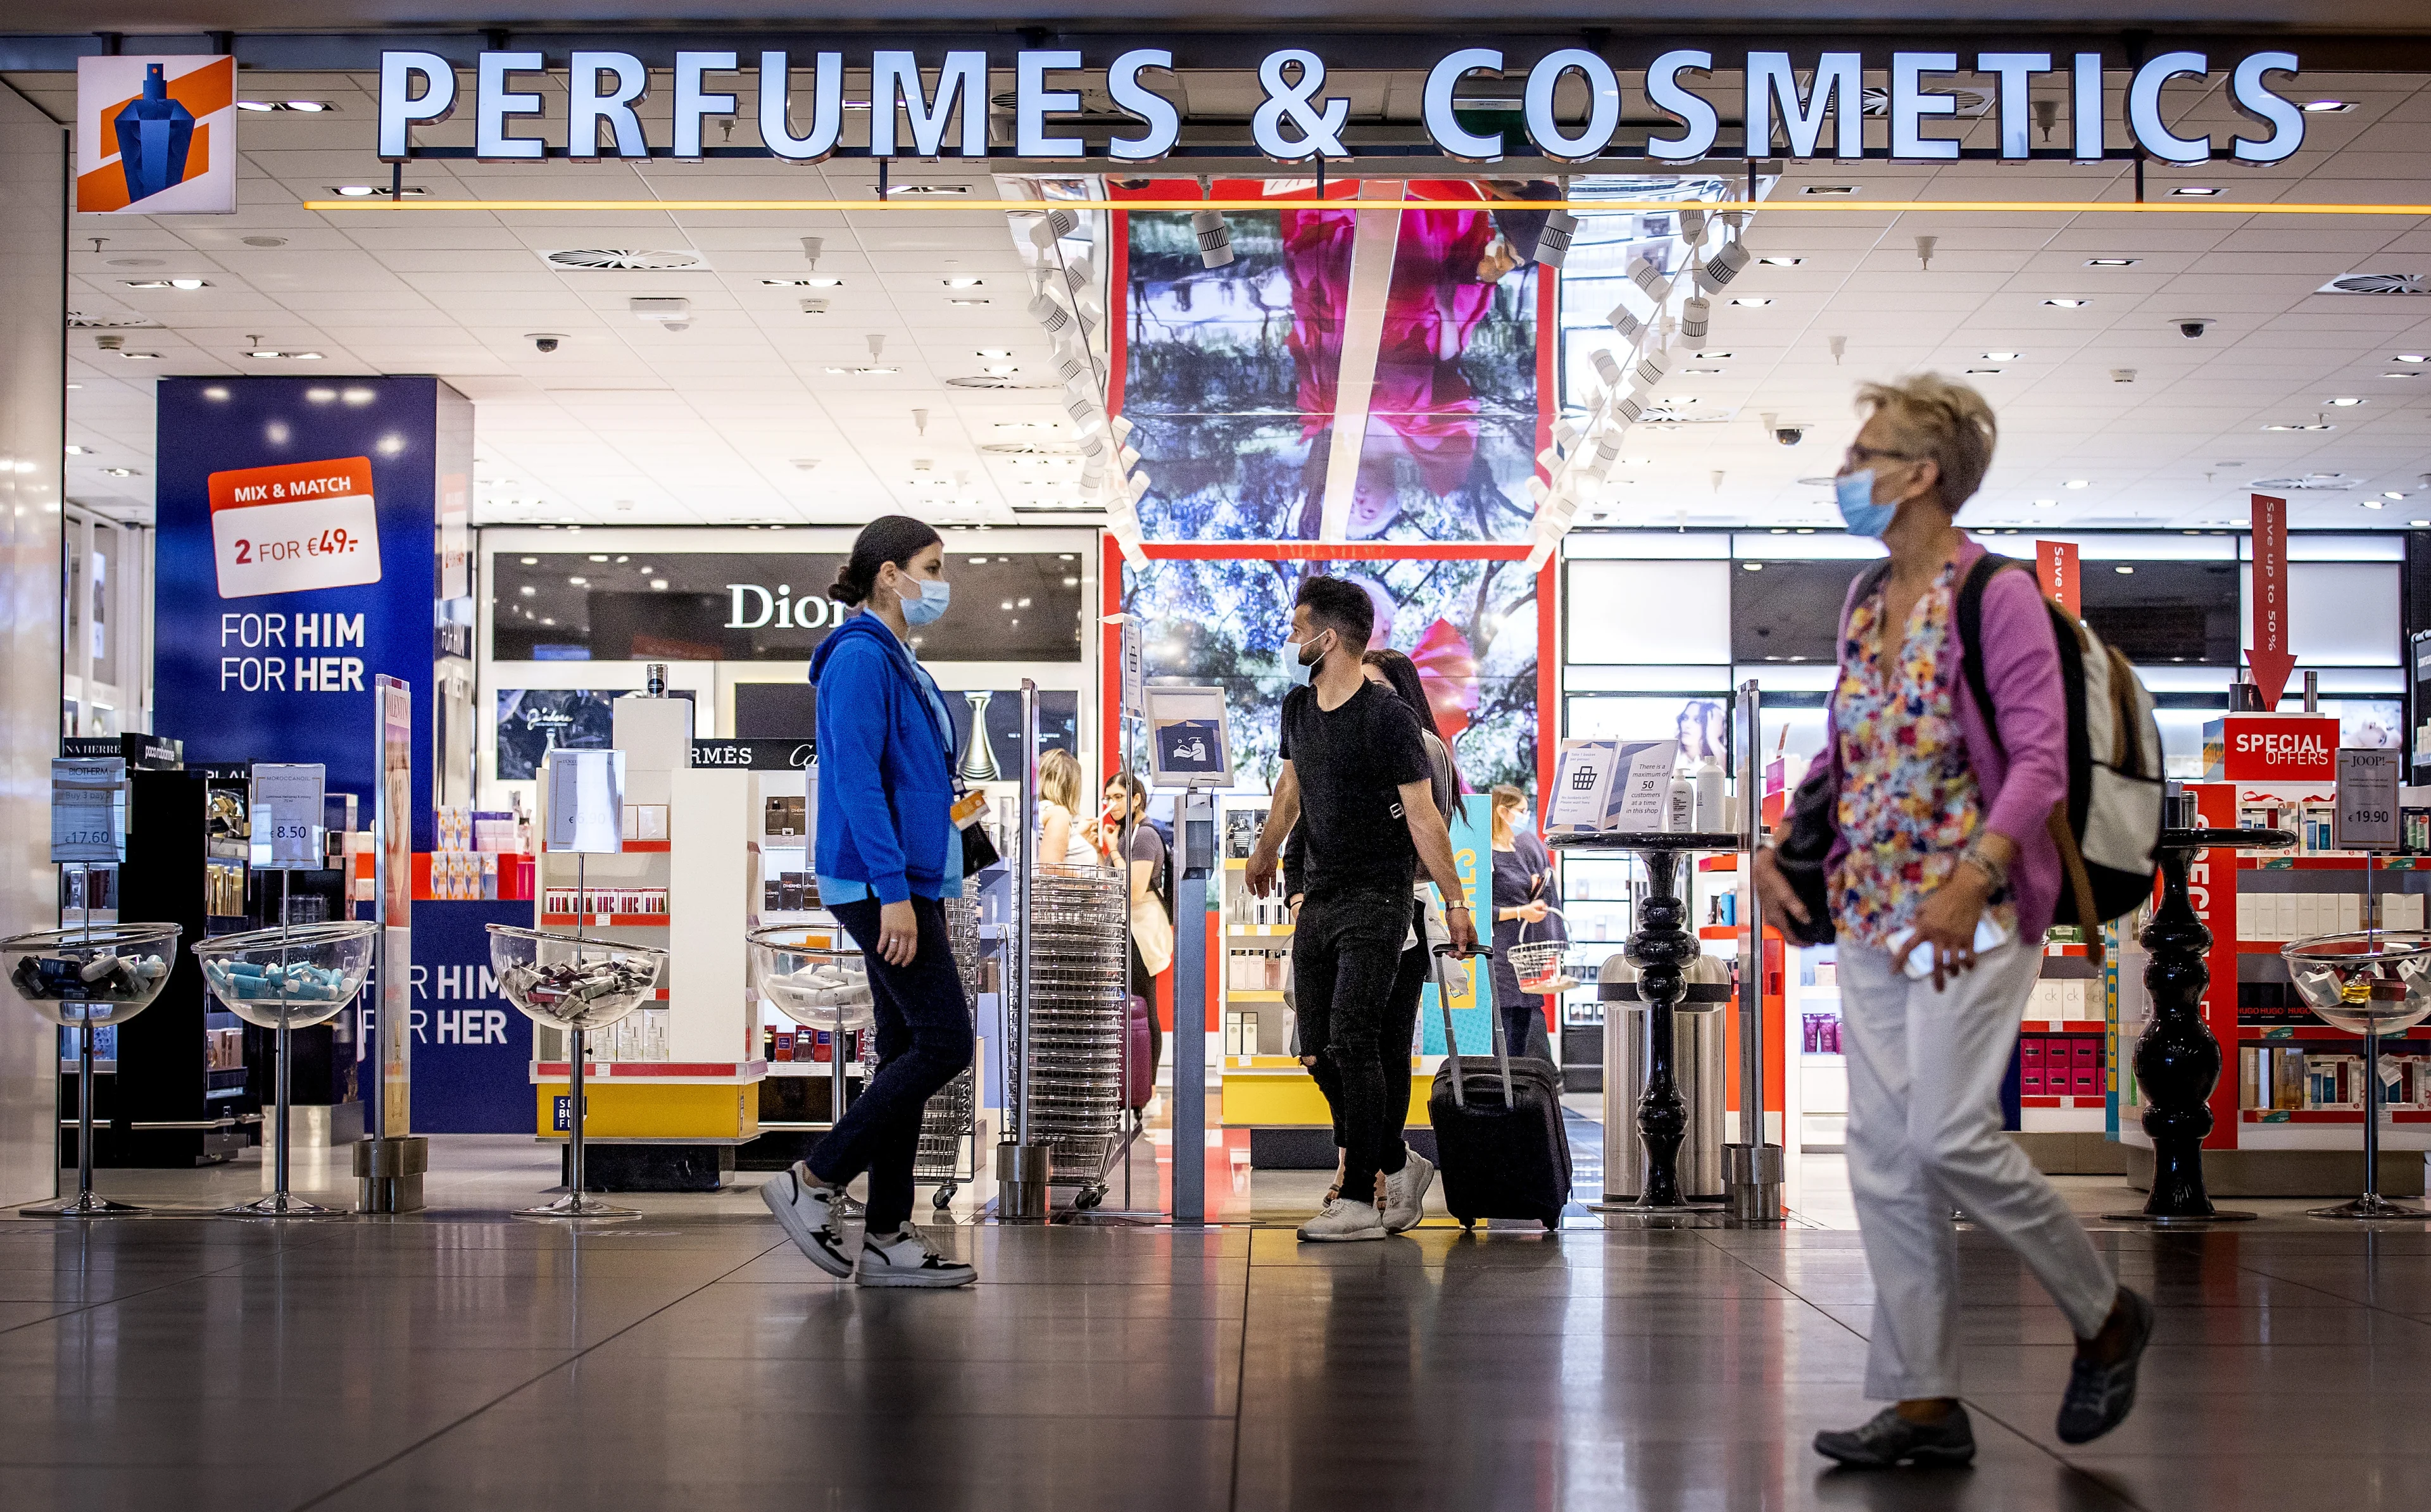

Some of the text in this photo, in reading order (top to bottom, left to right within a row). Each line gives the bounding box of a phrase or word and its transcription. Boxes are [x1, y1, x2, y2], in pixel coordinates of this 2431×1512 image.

[379, 48, 2306, 166] PERFUMES & COSMETICS
[234, 476, 351, 502] MIX & MATCH
[234, 539, 252, 565] 2
[259, 540, 300, 562] FOR
[2054, 546, 2064, 587] Save
[2266, 502, 2277, 651] Save up to 50%
[724, 584, 845, 628] Dior
[222, 613, 365, 647] FOR HIM
[222, 657, 365, 692] FOR HER
[2236, 734, 2328, 753] SPECIAL
[2266, 751, 2328, 765] OFFERS
[2351, 756, 2385, 768] JOOP!
[66, 792, 80, 800] Buy
[1642, 780, 1654, 789] 50
[2356, 811, 2389, 823] 19.90
[277, 826, 306, 839] 8.50
[363, 965, 506, 999] FR HIM
[2045, 988, 2057, 1001] ck
[2066, 988, 2079, 1001] ck
[363, 1009, 507, 1044] FR HER
